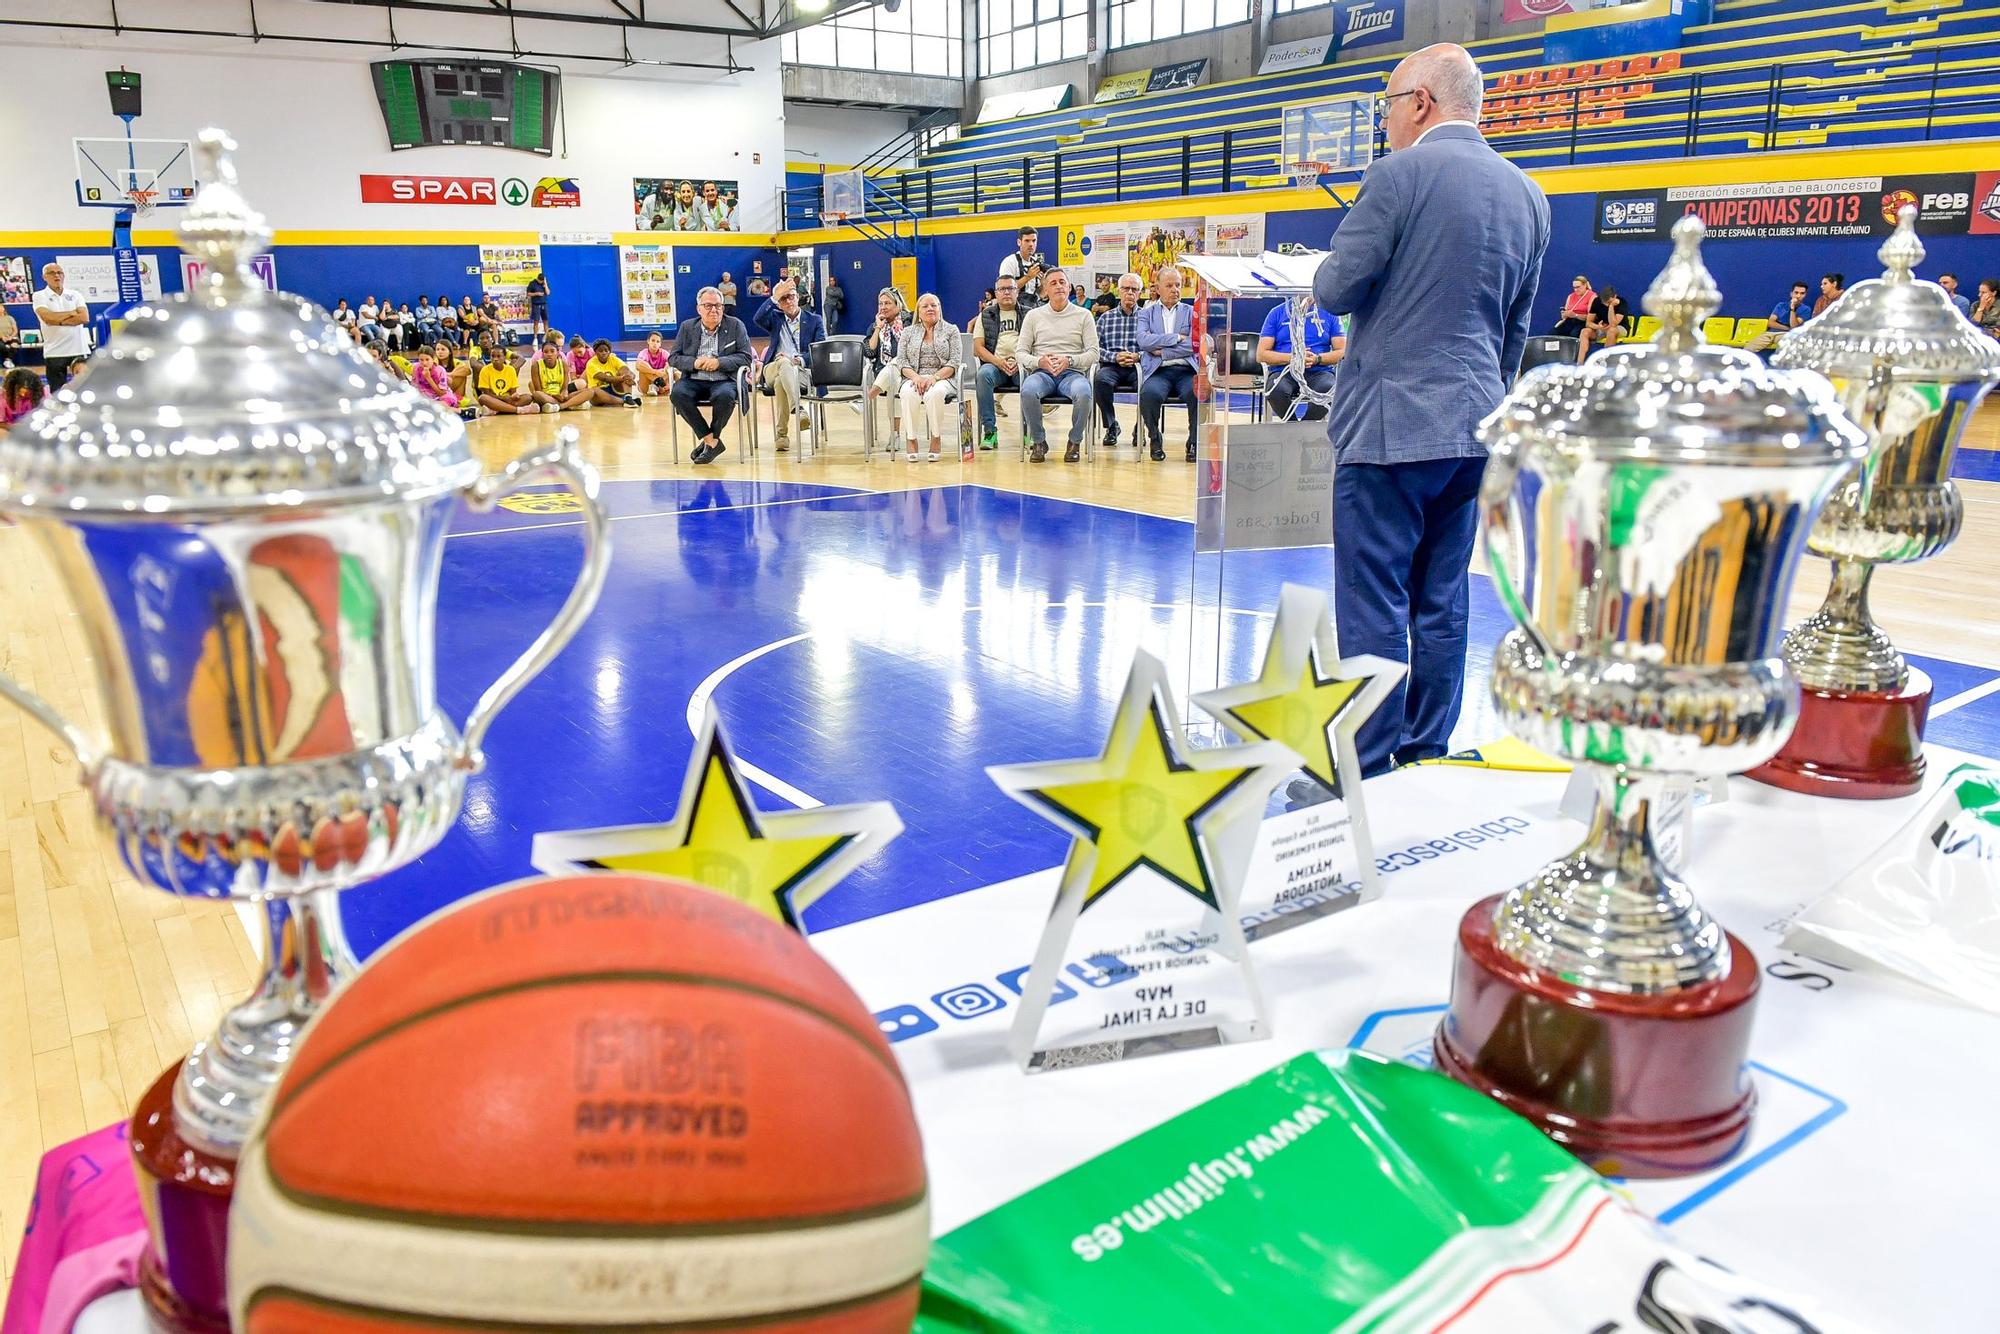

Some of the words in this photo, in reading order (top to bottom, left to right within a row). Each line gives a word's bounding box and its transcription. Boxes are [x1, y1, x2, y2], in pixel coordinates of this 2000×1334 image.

[1346, 2, 1395, 31] Tirma
[391, 179, 495, 201] SPAR
[1684, 197, 1801, 227] CAMPEONAS
[1805, 195, 1861, 225] 2013
[1717, 228, 1728, 237] DE
[1728, 227, 1758, 238] ESPAÑA
[1768, 226, 1795, 236] CLUBES
[1796, 225, 1829, 236] INFANTIL
[575, 1017, 746, 1094] FIBA
[575, 1101, 747, 1139] APPROVED
[1071, 1103, 1331, 1263] www.fujifilm.es
